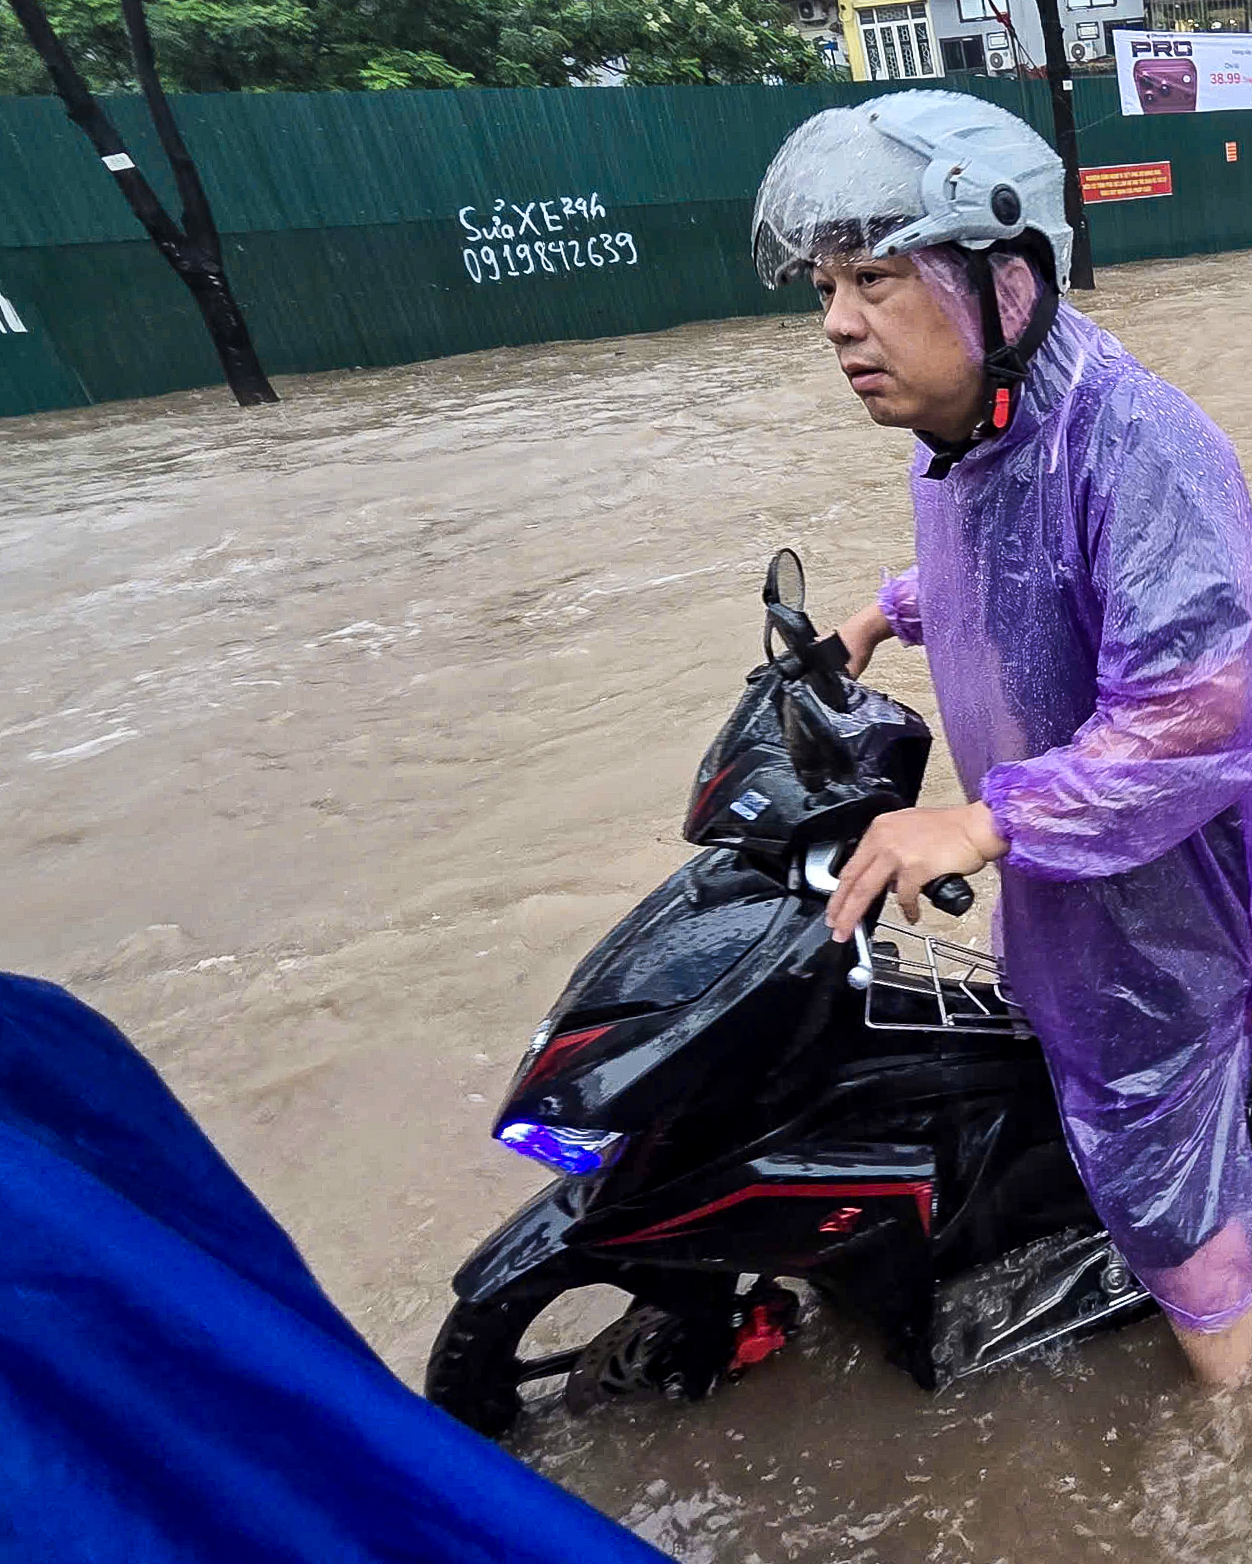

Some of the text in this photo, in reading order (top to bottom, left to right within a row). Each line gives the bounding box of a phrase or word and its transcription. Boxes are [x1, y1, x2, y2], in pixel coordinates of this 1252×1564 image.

[1131, 41, 1193, 57] PRO
[1210, 73, 1241, 84] 38.99
[458, 199, 516, 241] Sửa
[463, 232, 637, 283] 0919842639
